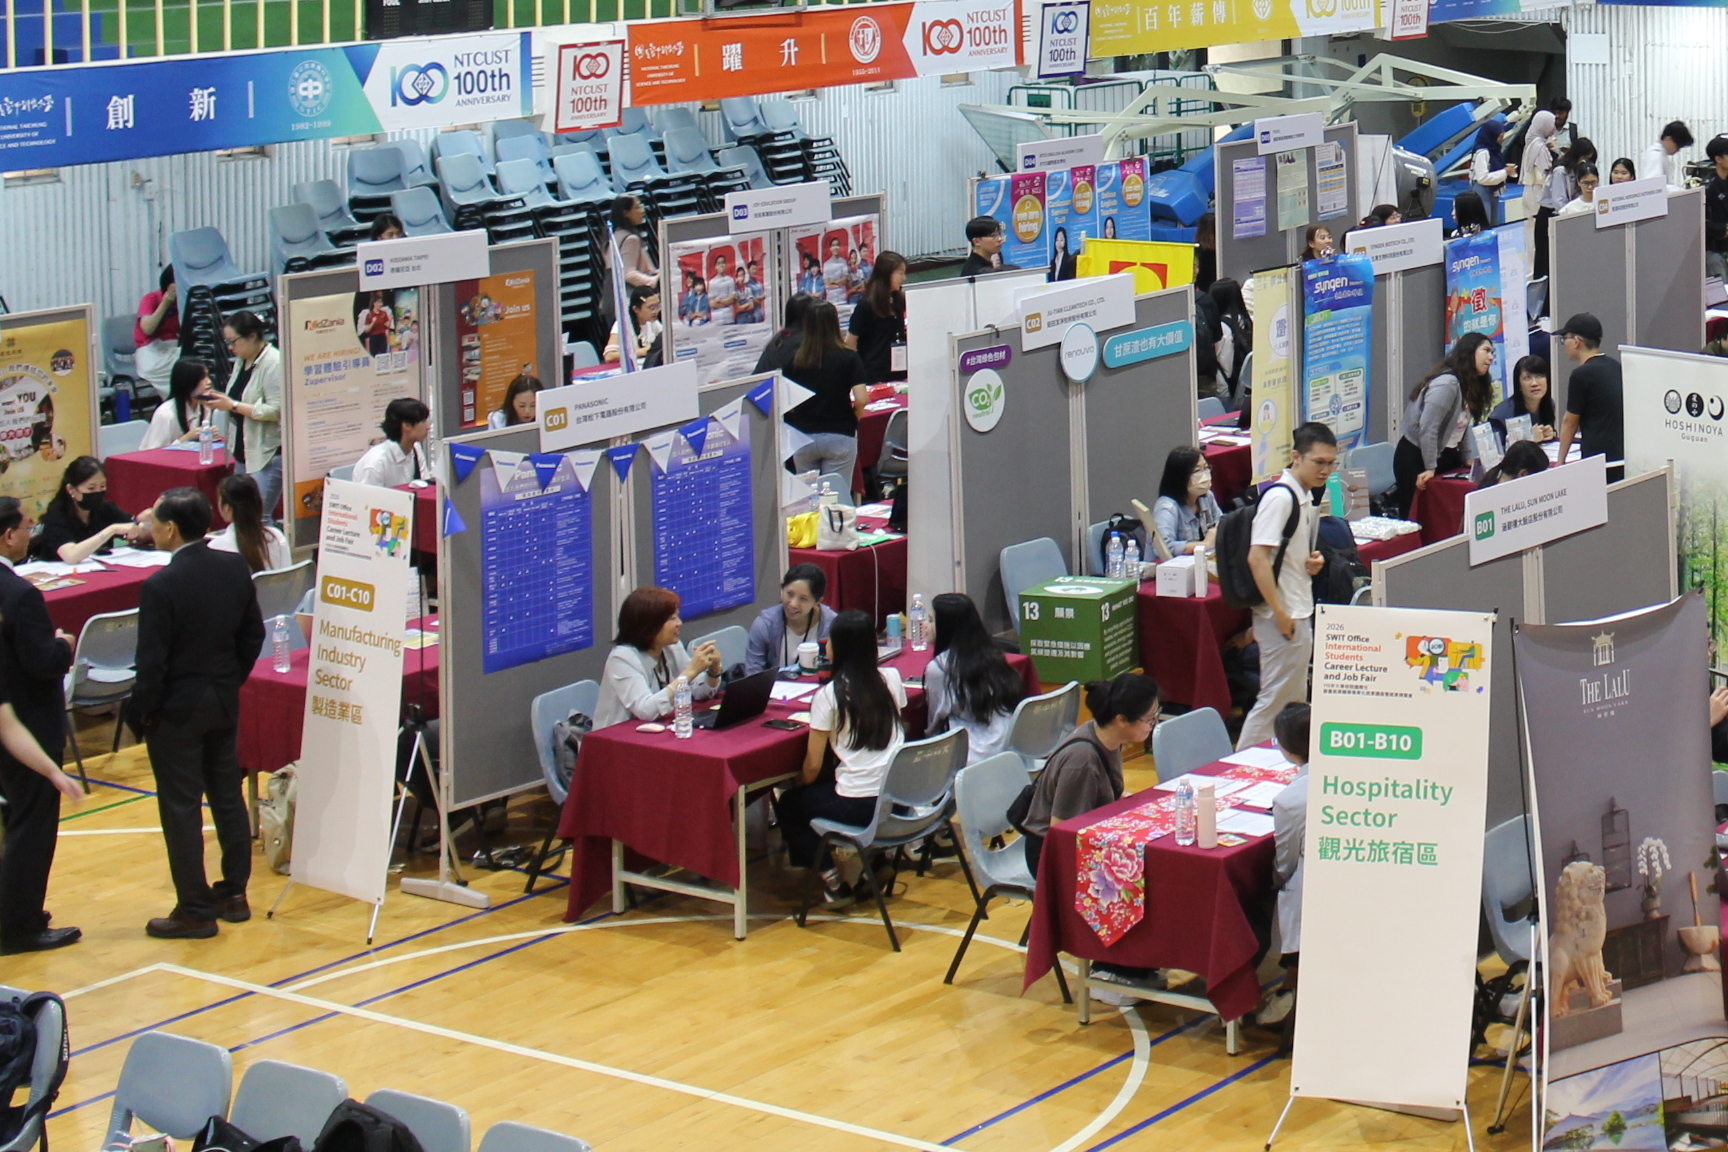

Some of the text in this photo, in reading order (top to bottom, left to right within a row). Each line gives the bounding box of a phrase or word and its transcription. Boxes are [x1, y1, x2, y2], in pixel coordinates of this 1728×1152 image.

[1401, 4, 1422, 12] NTCUST
[967, 8, 1008, 23] NTCUST
[1144, 0, 1226, 31] 百年薪傳
[1400, 13, 1421, 26] 100th
[967, 24, 1008, 46] 100th
[1049, 38, 1077, 48] NTCUST
[968, 46, 1008, 57] ANNIVERSARY
[1049, 48, 1077, 61] 100th
[454, 50, 511, 68] NTCUST
[454, 68, 511, 95] 100th
[571, 84, 608, 97] NTCUST
[455, 94, 512, 107] ANNIVERSARY
[570, 97, 607, 113] 100th
[734, 207, 748, 218] D03
[1018, 221, 1038, 233] hiring
[366, 262, 384, 273] D02
[1452, 255, 1480, 273] syngen
[1314, 277, 1348, 294] syngen
[1470, 288, 1487, 313] 徵
[505, 305, 521, 314] Join
[1027, 317, 1041, 329] C02
[1463, 315, 1497, 333] 的就是你
[1114, 330, 1184, 358] 甘蔗渣也有大價值
[304, 374, 346, 386] Zupervisor
[17, 391, 36, 403] YOU
[574, 398, 609, 410] PANASONIC
[546, 413, 566, 427] C01
[1665, 419, 1724, 436] HOSHINOYA
[1681, 433, 1708, 443] Guguan
[455, 452, 476, 461] Panasonic
[1501, 488, 1567, 515] THE LALU, SUN MOON LAKE
[326, 525, 360, 538] Career Lecture
[1476, 516, 1493, 535] B01
[336, 535, 345, 543] Job
[345, 537, 354, 545] Fair
[327, 583, 371, 605] C01-C10
[1023, 602, 1040, 620] 13
[1101, 602, 1110, 622] 13
[1326, 623, 1345, 631] 2026
[319, 619, 402, 657] Manufacturing
[1326, 633, 1370, 643] SWIT Office
[1325, 642, 1381, 653] International
[317, 644, 367, 673] Industry
[1324, 652, 1364, 662] Students
[1324, 662, 1388, 674] Career Lecture
[315, 669, 353, 692] Sector
[1324, 673, 1377, 683] and Job Fair
[311, 695, 363, 725] 製造業區
[1330, 730, 1412, 752] B01-B10
[1323, 775, 1453, 806] Hospitality
[1321, 805, 1398, 828] Sector
[1318, 836, 1439, 866] 觀光旅宿區
